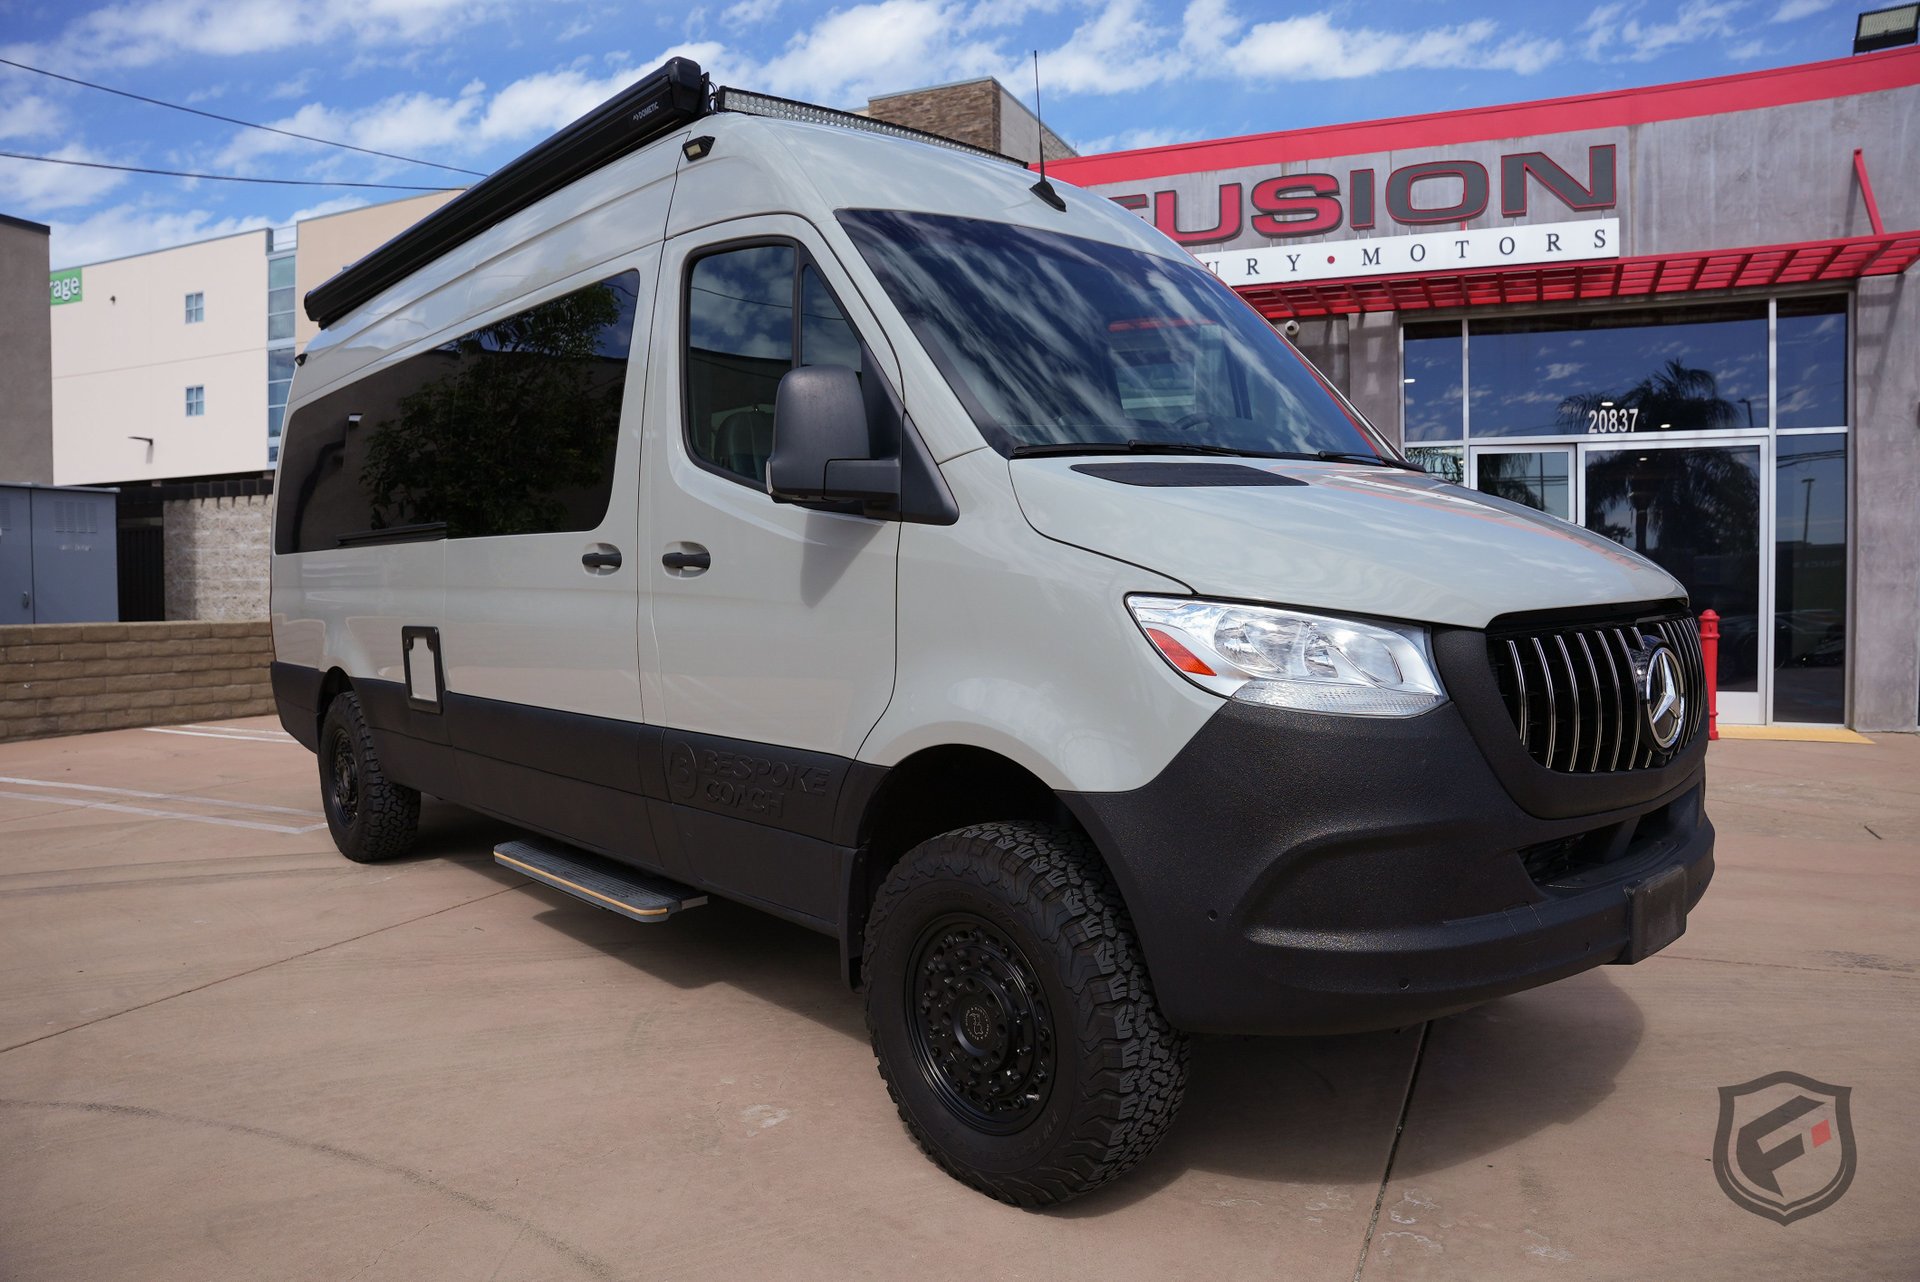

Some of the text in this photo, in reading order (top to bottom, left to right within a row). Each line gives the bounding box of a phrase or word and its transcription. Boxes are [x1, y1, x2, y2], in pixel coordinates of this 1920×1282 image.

[1361, 229, 1606, 267] MOTORS
[1588, 408, 1639, 433] 20837
[702, 749, 832, 797] BESPOKE
[705, 779, 785, 819] COACH
